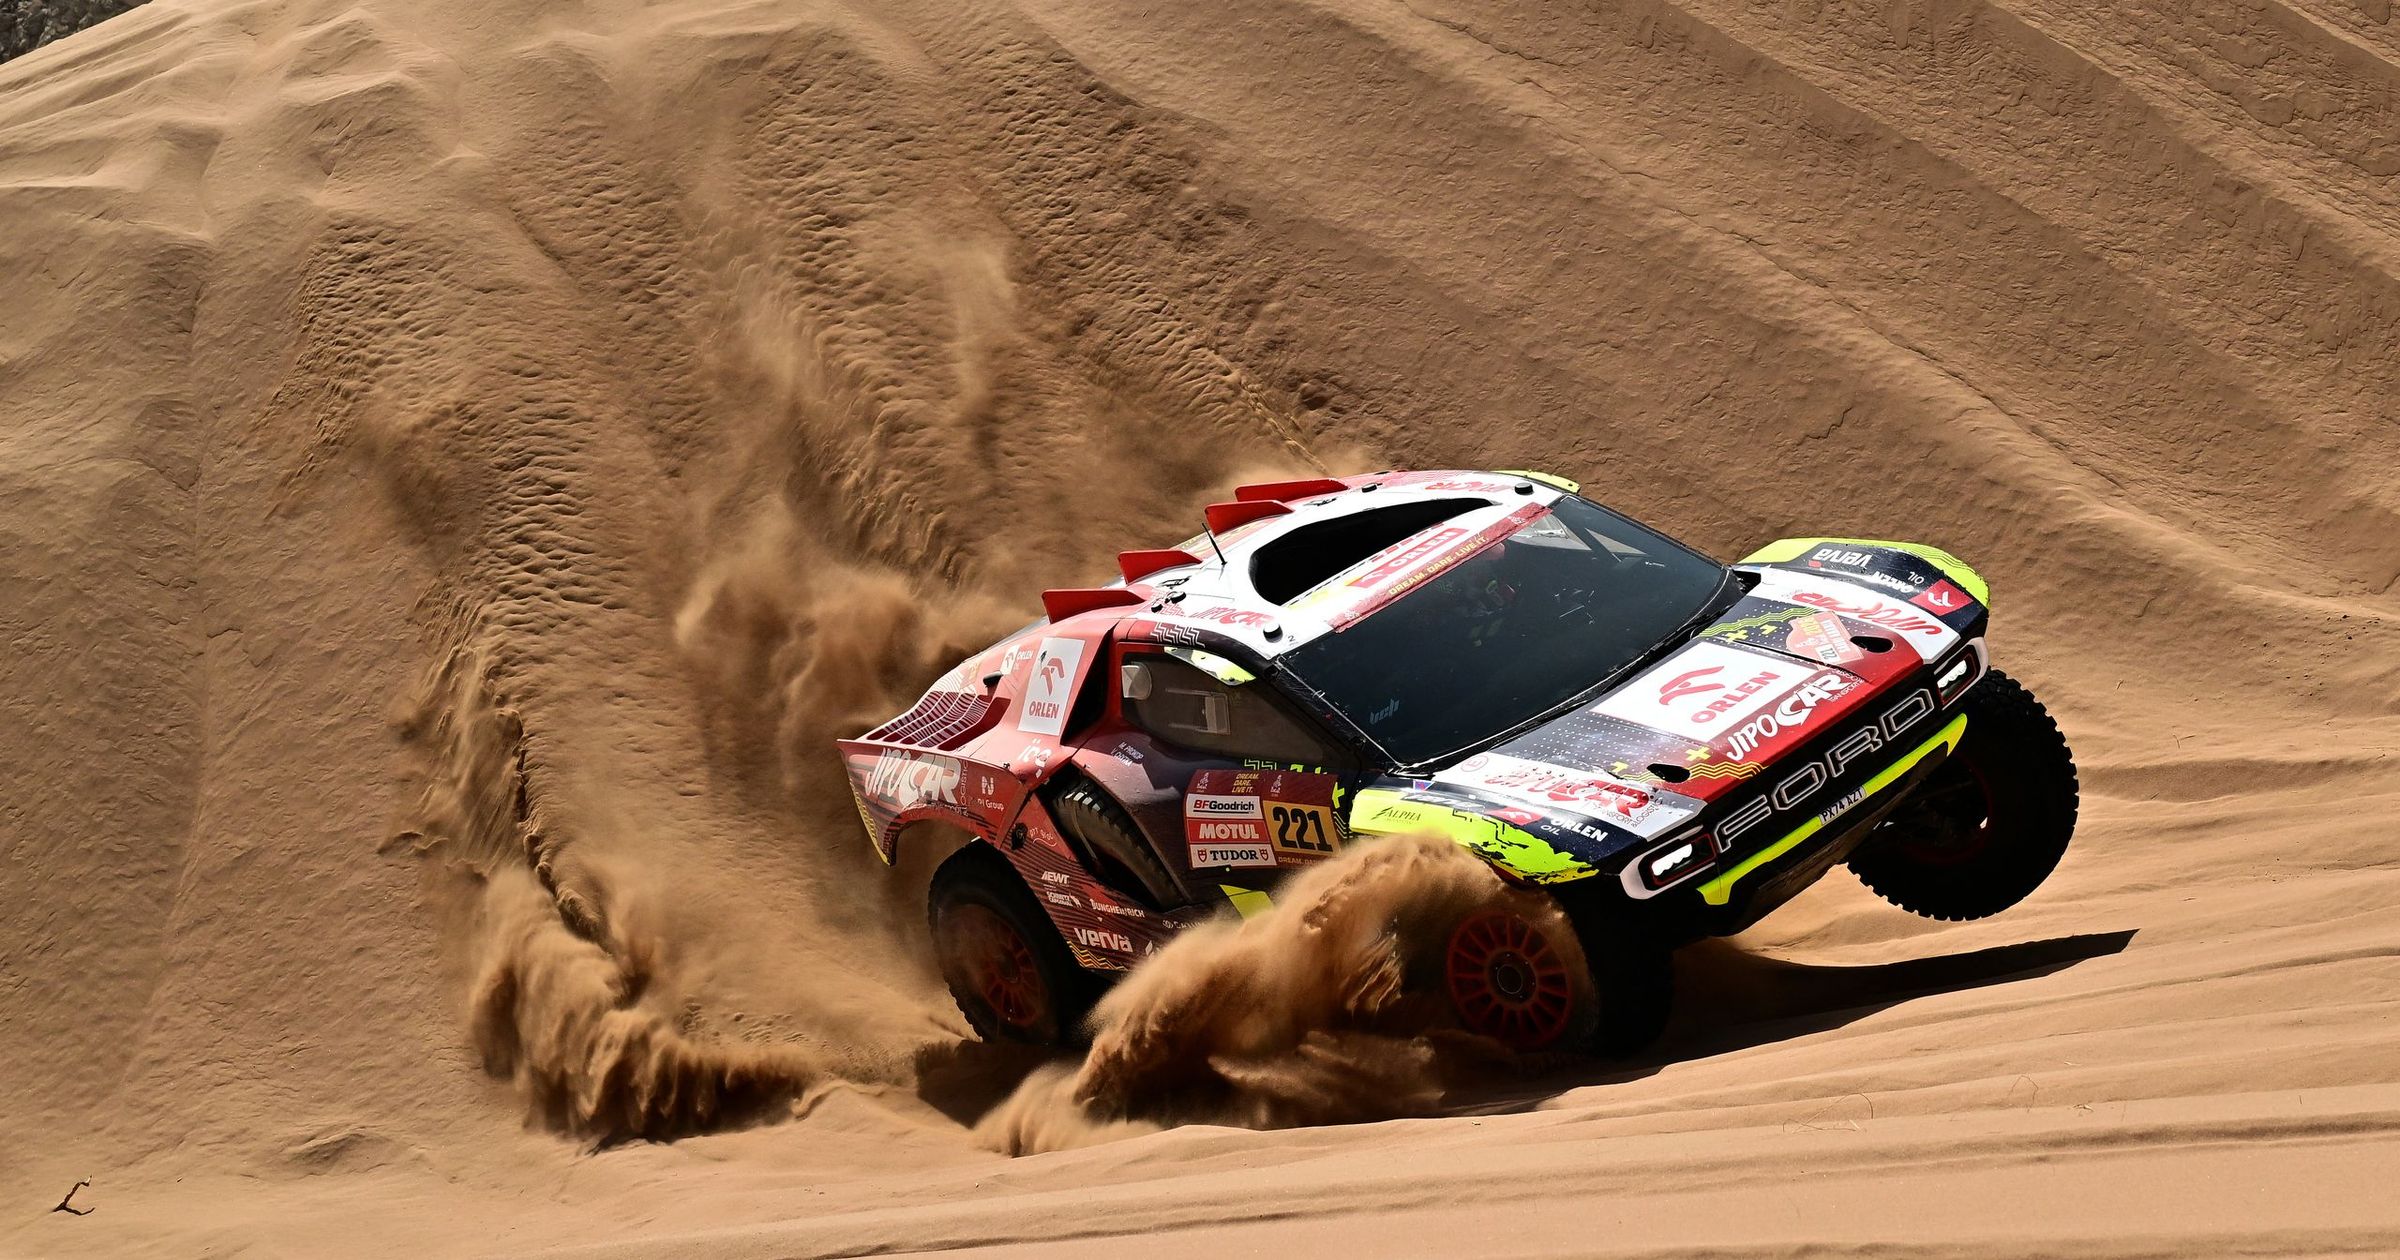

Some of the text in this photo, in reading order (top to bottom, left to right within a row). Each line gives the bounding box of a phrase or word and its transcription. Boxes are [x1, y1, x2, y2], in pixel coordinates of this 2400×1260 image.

[1389, 531, 1458, 567] ORLEN
[1812, 548, 1873, 569] verva
[1389, 573, 1428, 595] DREAM.
[1427, 556, 1456, 573] DARE.
[1455, 544, 1477, 557] LIVE
[1908, 571, 1925, 584] OIL
[1691, 671, 1781, 723] ORLEN
[1029, 701, 1060, 719] ORLEN
[1726, 674, 1849, 761] JIPOCAR
[865, 747, 961, 811] JIPOCAR
[1714, 688, 1934, 853] FORD
[1193, 799, 1255, 811] BFGoodrich
[1822, 801, 1845, 822] PX74
[1199, 823, 1260, 840] MOTUL
[1272, 806, 1334, 853] 221
[1540, 824, 1560, 836] OIL
[1551, 817, 1608, 842] ORLEN
[1210, 849, 1259, 861] TUDOR
[1074, 927, 1133, 953] verva
